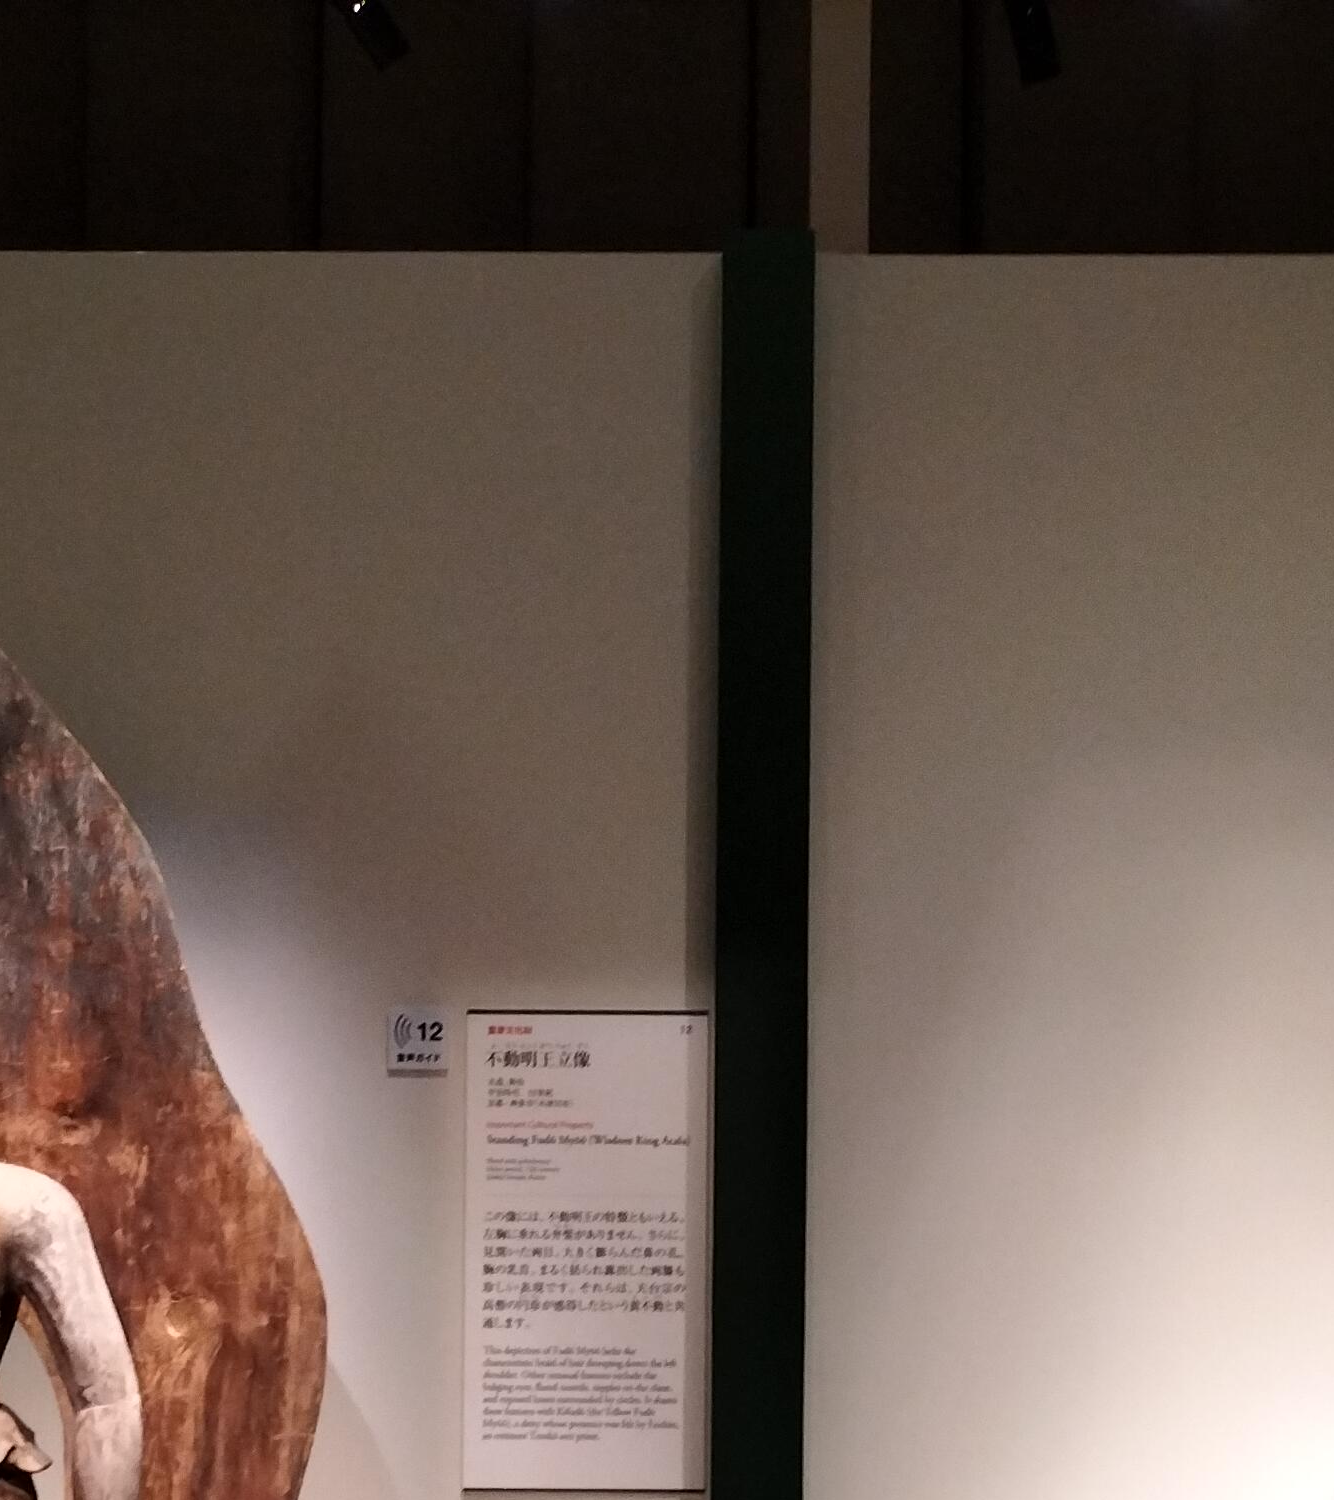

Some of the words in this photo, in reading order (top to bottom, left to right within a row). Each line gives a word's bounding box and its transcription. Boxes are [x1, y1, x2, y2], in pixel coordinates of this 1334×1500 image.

[417, 1021, 444, 1041] 12
[484, 1050, 591, 1069] 不動明王立像
